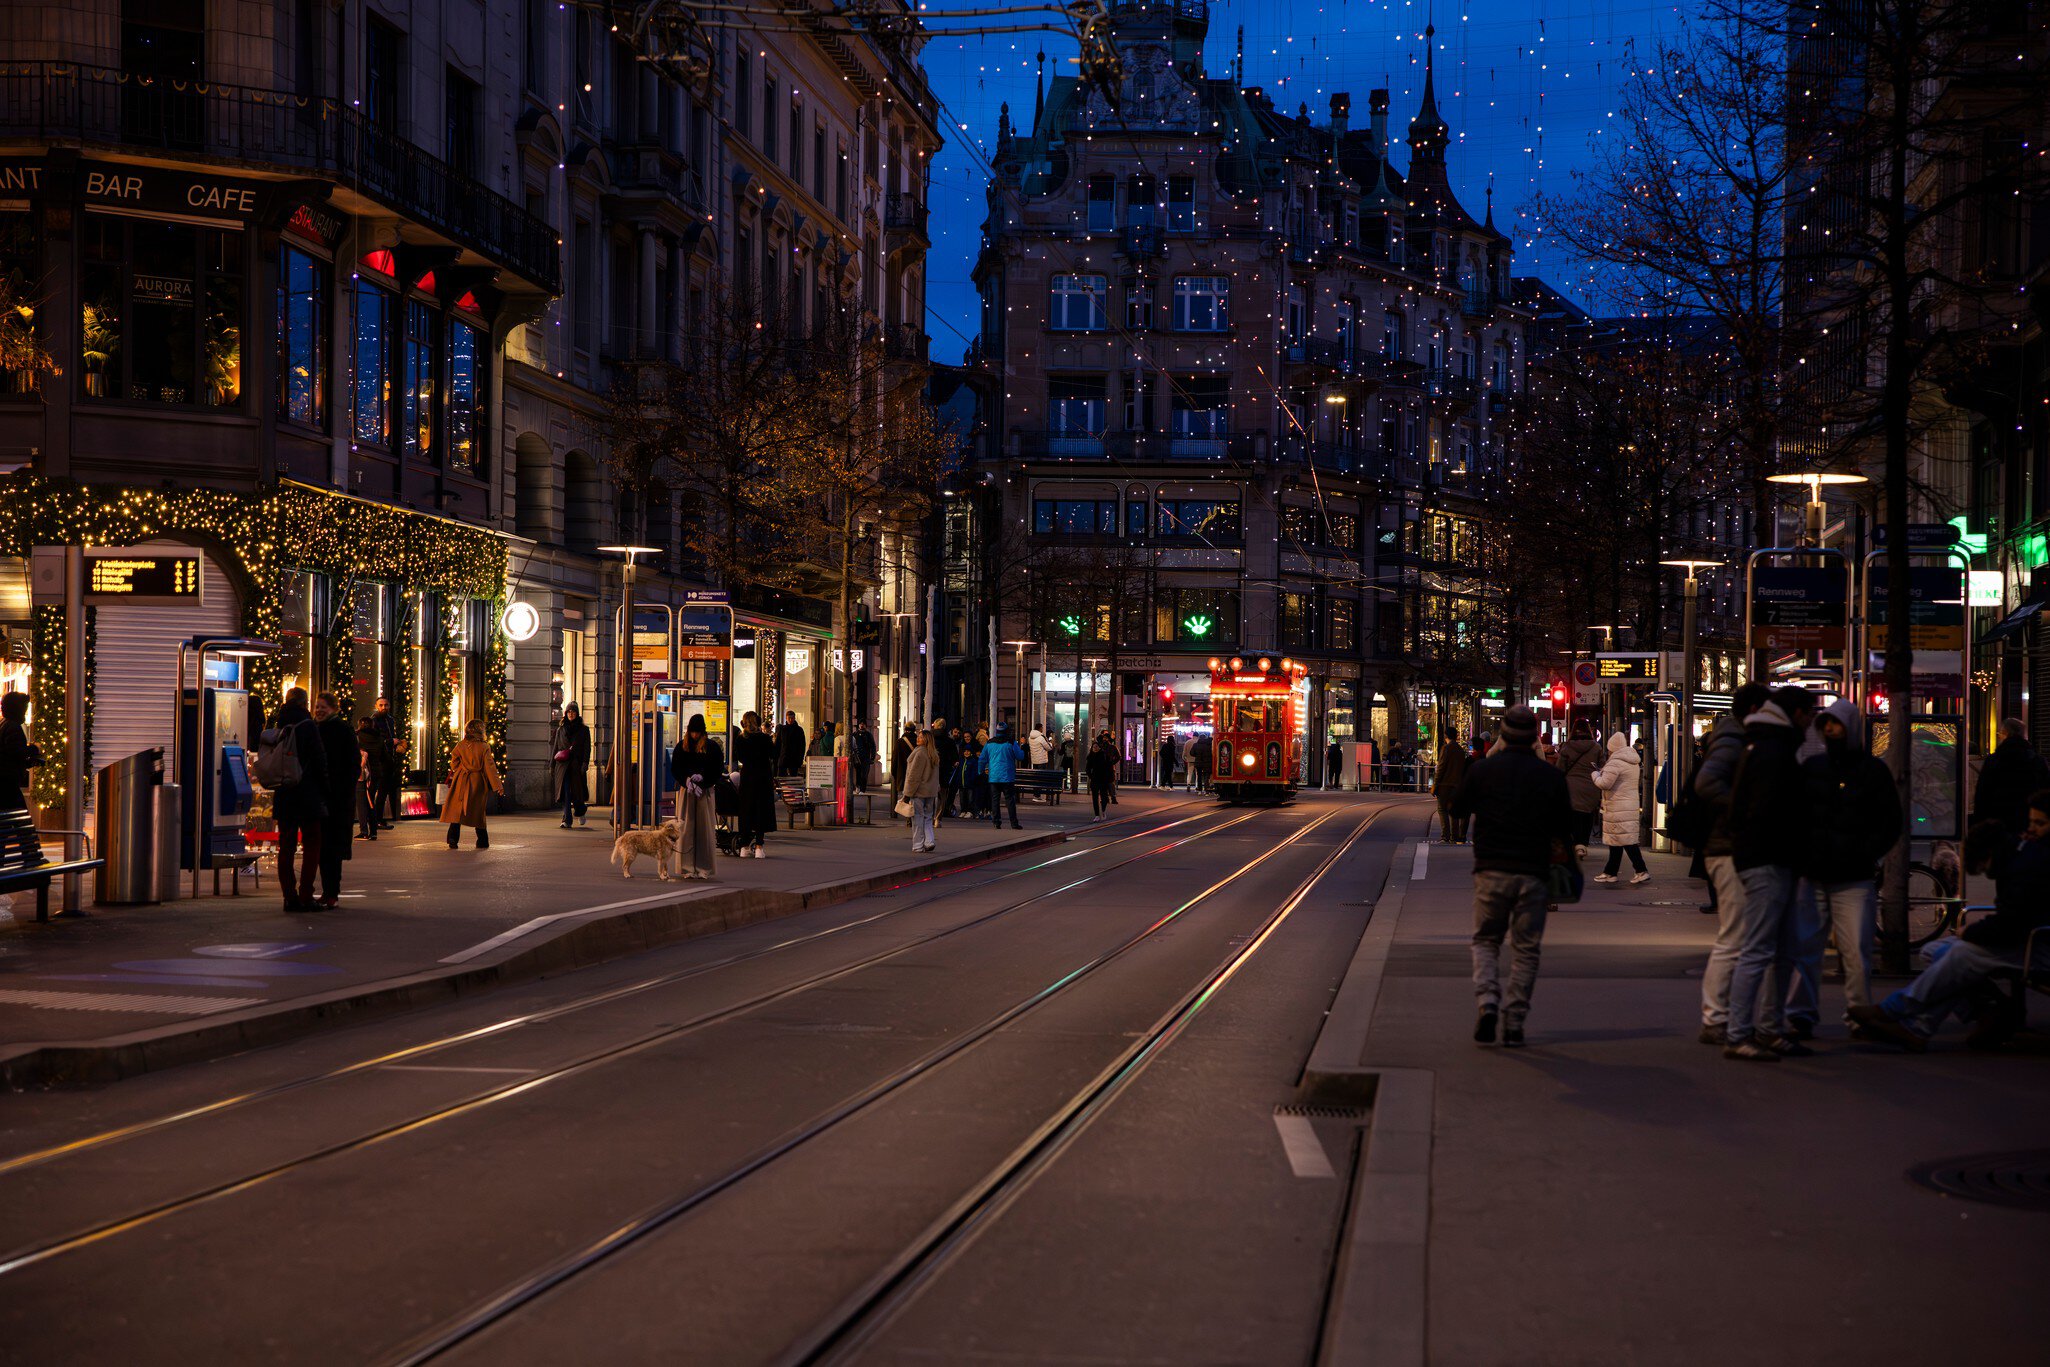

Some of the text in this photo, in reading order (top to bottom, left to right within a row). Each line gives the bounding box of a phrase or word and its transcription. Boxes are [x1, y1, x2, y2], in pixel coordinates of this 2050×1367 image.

[86, 172, 257, 212] BAR CAFE
[135, 278, 192, 294] AURORA
[1757, 586, 1806, 598] Rennweg
[1767, 610, 1776, 623] 7
[689, 637, 694, 645] 7
[1766, 634, 1776, 647] 6
[688, 650, 694, 659] 6
[835, 651, 861, 660] TG
